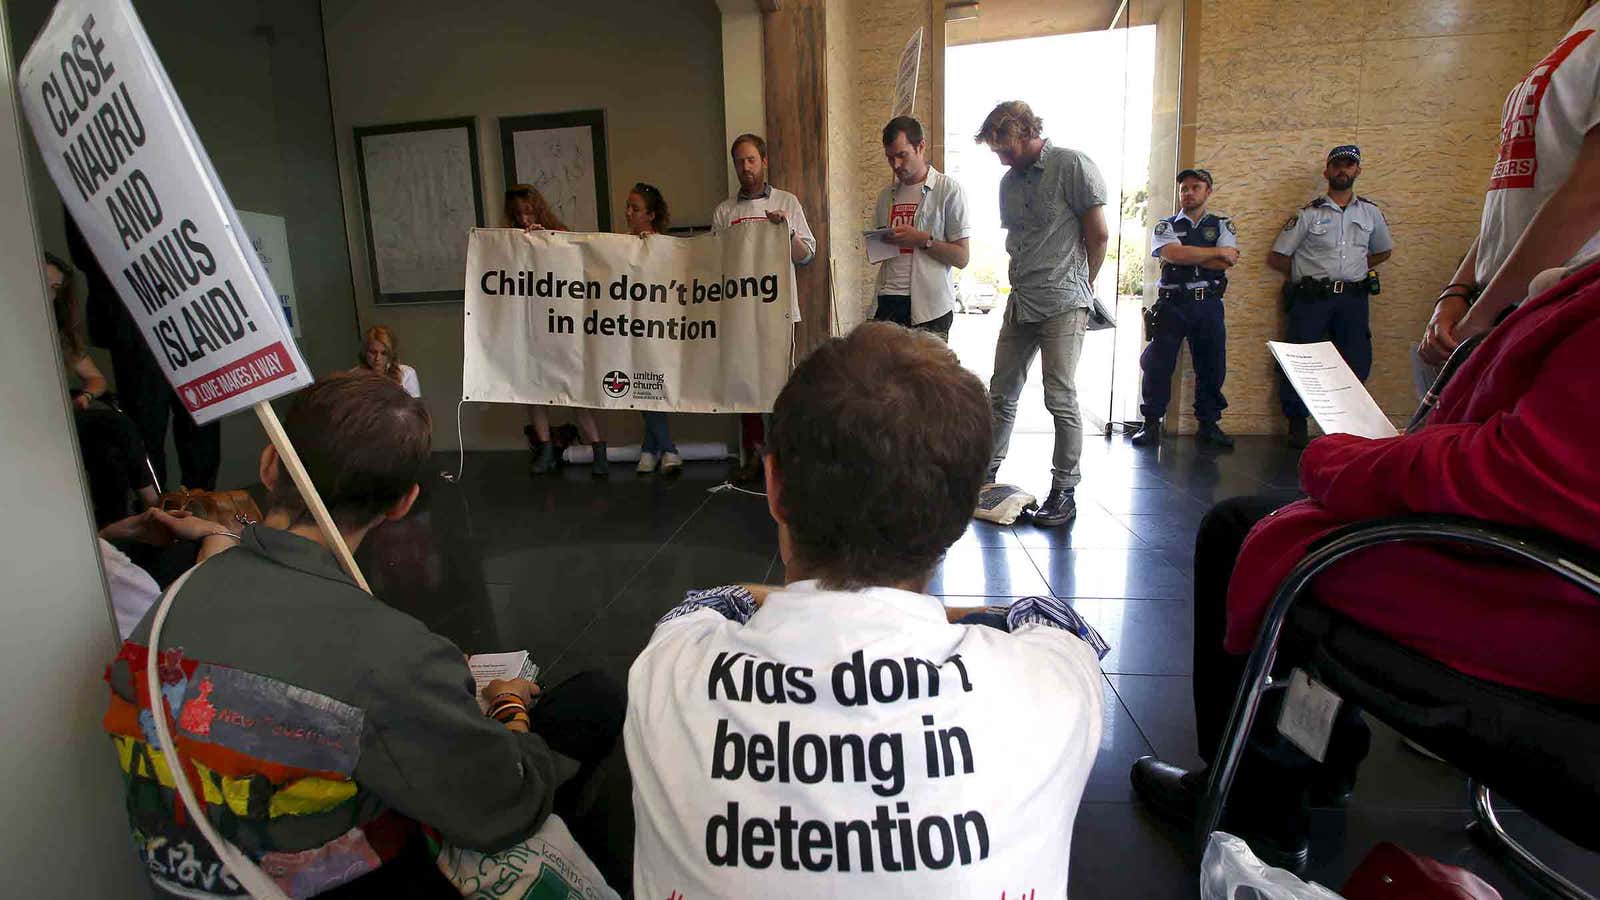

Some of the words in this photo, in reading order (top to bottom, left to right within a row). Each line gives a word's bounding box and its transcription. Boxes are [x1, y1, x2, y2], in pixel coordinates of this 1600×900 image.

[42, 13, 115, 137] CLOSE
[62, 81, 146, 202] NAURU
[105, 168, 163, 250] AND
[123, 218, 217, 316] MANUS
[480, 270, 600, 300] Children
[609, 275, 687, 306] don't
[692, 272, 779, 304] belong
[153, 280, 258, 371] ISLAND!
[548, 308, 574, 334] in
[583, 309, 717, 340] detention
[196, 380, 222, 402] LOVE
[217, 366, 253, 394] MAKES
[248, 363, 262, 382] A
[255, 352, 285, 377] WAY
[633, 371, 664, 383] uniting
[633, 380, 663, 390] church
[710, 719, 905, 797] belong
[922, 714, 975, 779] in
[705, 800, 990, 873] detention
